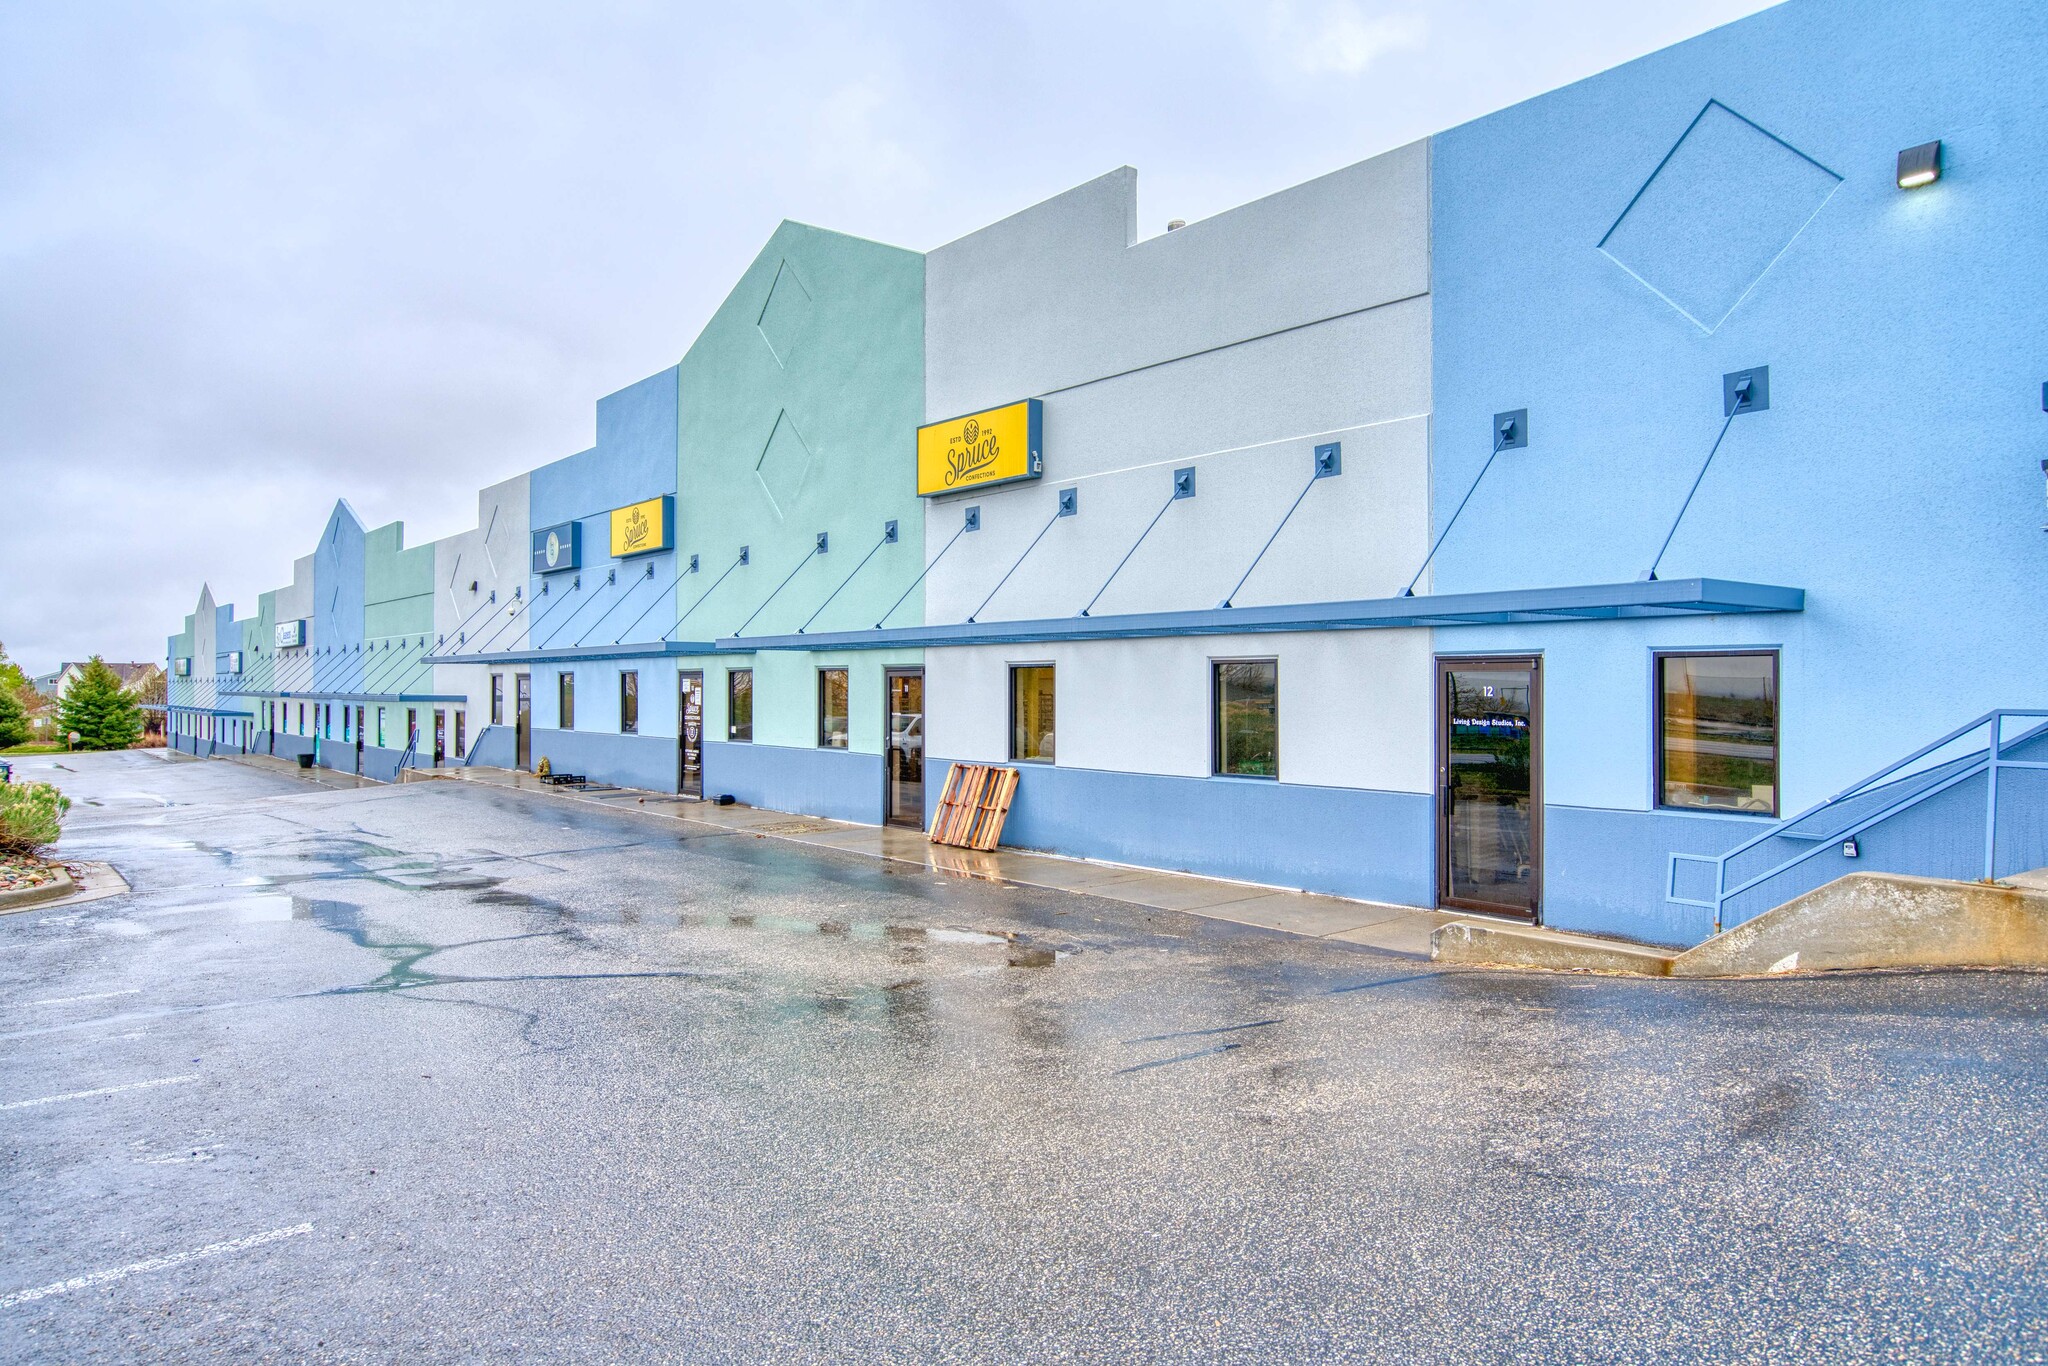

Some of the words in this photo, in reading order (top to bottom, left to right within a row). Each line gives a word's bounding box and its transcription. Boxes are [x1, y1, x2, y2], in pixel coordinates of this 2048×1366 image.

[950, 436, 961, 444] ESTD
[981, 428, 992, 437] 1992
[945, 435, 999, 486] Spruce
[965, 470, 996, 482] CONFECTIONS
[623, 519, 649, 551] Spruce
[1483, 686, 1494, 697] 12
[1453, 718, 1471, 726] Living
[1471, 718, 1490, 727] Design
